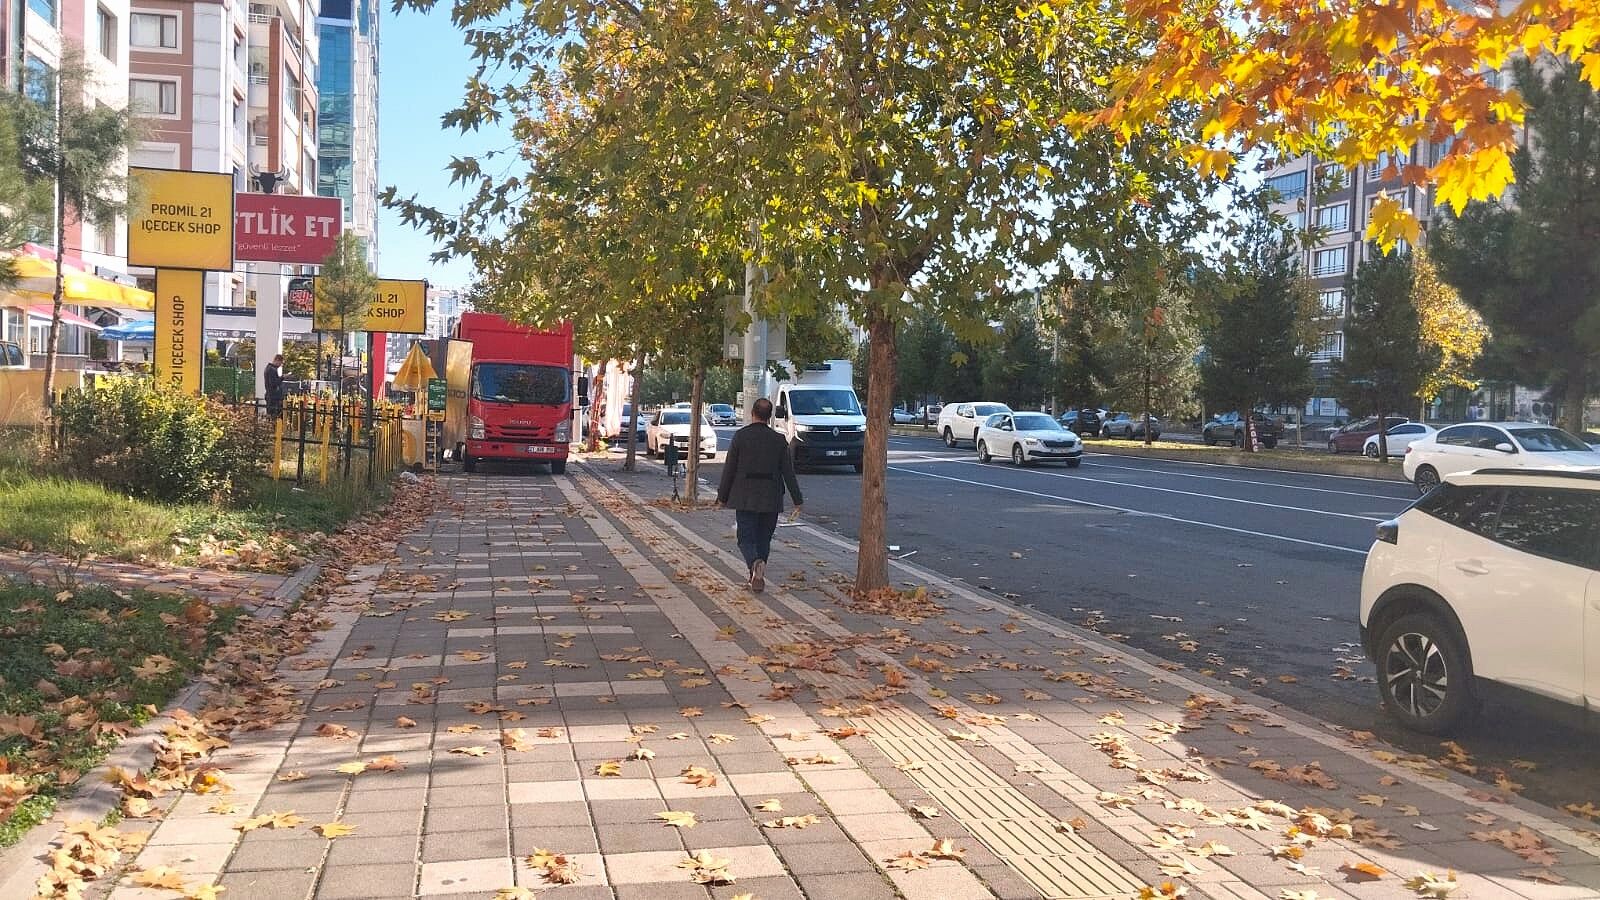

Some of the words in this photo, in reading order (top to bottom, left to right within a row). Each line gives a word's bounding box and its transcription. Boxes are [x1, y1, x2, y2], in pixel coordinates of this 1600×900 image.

[200, 206, 212, 218] 21
[235, 205, 296, 236] TLİK
[304, 215, 335, 238] ET
[188, 223, 221, 235] SHOP
[388, 293, 398, 304] 21
[173, 295, 184, 326] SHOP
[376, 307, 405, 318] SHOP
